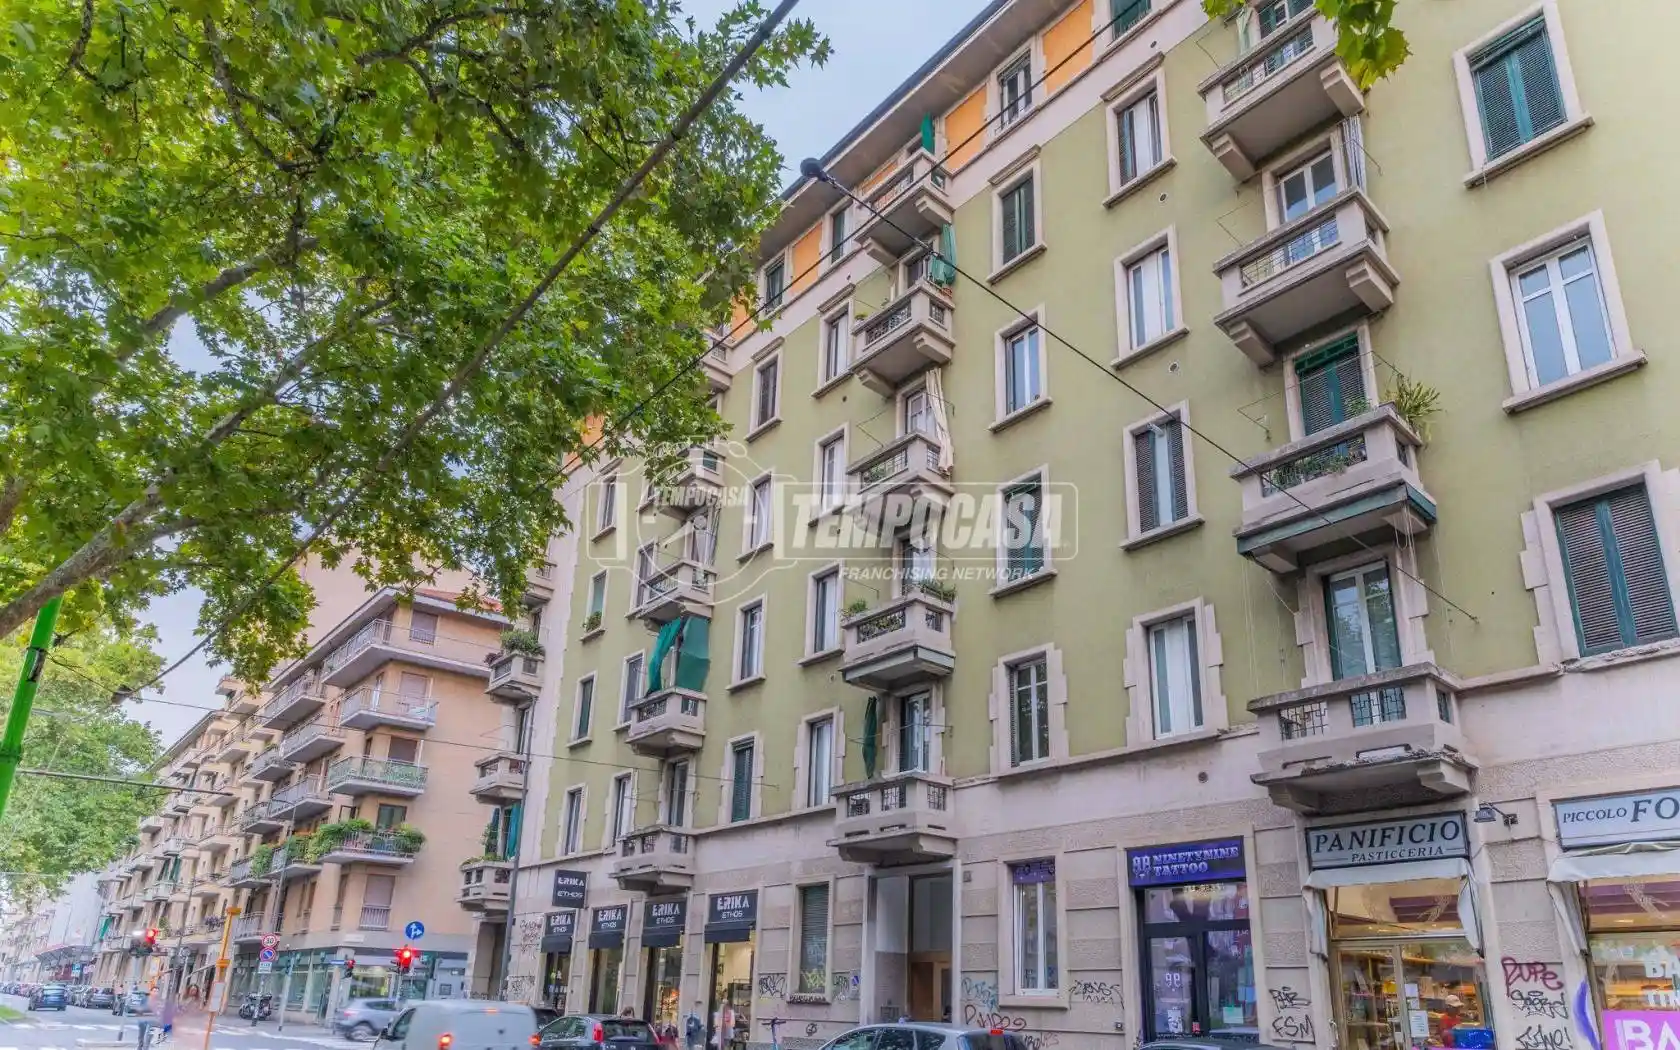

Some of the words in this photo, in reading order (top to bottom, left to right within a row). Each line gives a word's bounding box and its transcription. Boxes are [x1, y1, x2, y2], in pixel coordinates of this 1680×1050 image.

[1563, 807, 1627, 823] PICCOLO
[1630, 797, 1680, 822] FO
[1314, 820, 1460, 853] PANIFICIO
[1153, 847, 1239, 864] NINETYNINE
[1351, 846, 1444, 862] PASTICCERIA
[1153, 861, 1208, 877] TATTOO
[652, 903, 680, 917] ERIKA
[717, 896, 750, 911] ERIKA
[550, 914, 572, 927] ERIKA
[598, 908, 621, 922] ERIKA
[656, 916, 675, 925] ETHOS
[722, 910, 743, 919] ETHOS
